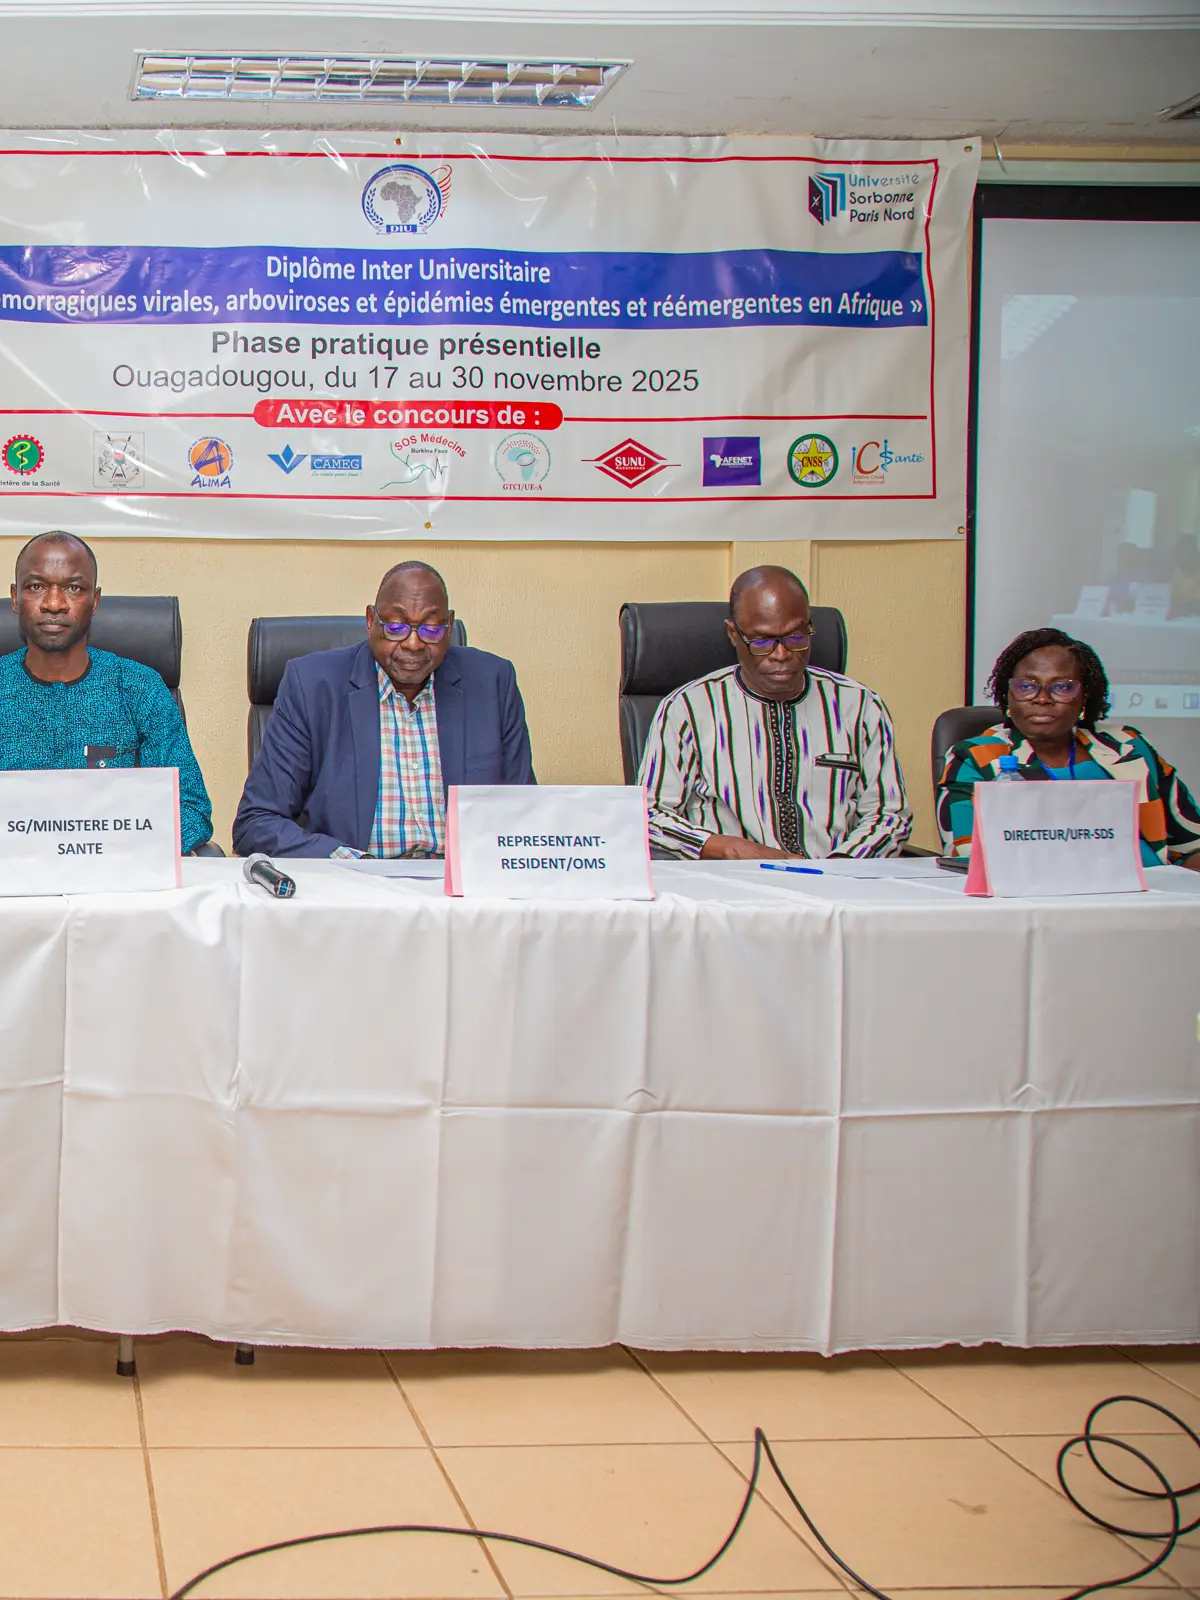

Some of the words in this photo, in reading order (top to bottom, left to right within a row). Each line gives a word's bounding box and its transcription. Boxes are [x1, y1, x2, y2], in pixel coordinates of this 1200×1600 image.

[849, 173, 919, 187] Université
[849, 191, 914, 205] Sorbonne
[849, 209, 879, 222] Paris
[883, 207, 915, 221] Nord
[266, 255, 355, 283] Diplôme
[362, 258, 413, 281] Inter
[419, 257, 551, 284] Universitaire
[143, 289, 219, 316] virales,
[225, 287, 350, 313] arboviroses
[356, 295, 378, 314] et
[383, 290, 494, 318] épidémies
[499, 291, 621, 321] émergentes
[627, 298, 647, 317] et
[653, 293, 802, 319] réémergentes
[808, 298, 832, 314] en
[838, 291, 904, 320] Afrique
[212, 330, 301, 354] Phase
[311, 332, 429, 360] pratique
[439, 332, 602, 360] présentielle
[112, 364, 315, 394] Ouagadougou,
[324, 365, 357, 389] du
[369, 366, 399, 389] 17
[408, 372, 442, 389] au
[452, 365, 484, 390] 30
[494, 368, 623, 393] novembre
[631, 369, 700, 393] 2025
[276, 403, 338, 424] Avec
[346, 403, 365, 424] le
[373, 406, 489, 426] concours
[497, 405, 526, 426] de
[394, 435, 418, 451] SOS
[420, 433, 467, 458] Médecins
[313, 458, 360, 469] CAMEG
[614, 456, 646, 467] SUNU
[722, 456, 753, 464] AFENET
[801, 456, 823, 467] CNSS
[7, 819, 109, 834] SG/MINISTERE
[113, 818, 131, 831] DE
[136, 818, 153, 831] LA
[497, 835, 606, 847] REPRESENTANT-
[1003, 827, 1115, 843] DIRECTEUR/UFR-SDS
[57, 842, 103, 855] SANTE
[501, 857, 606, 871] RESIDENT/OMS
